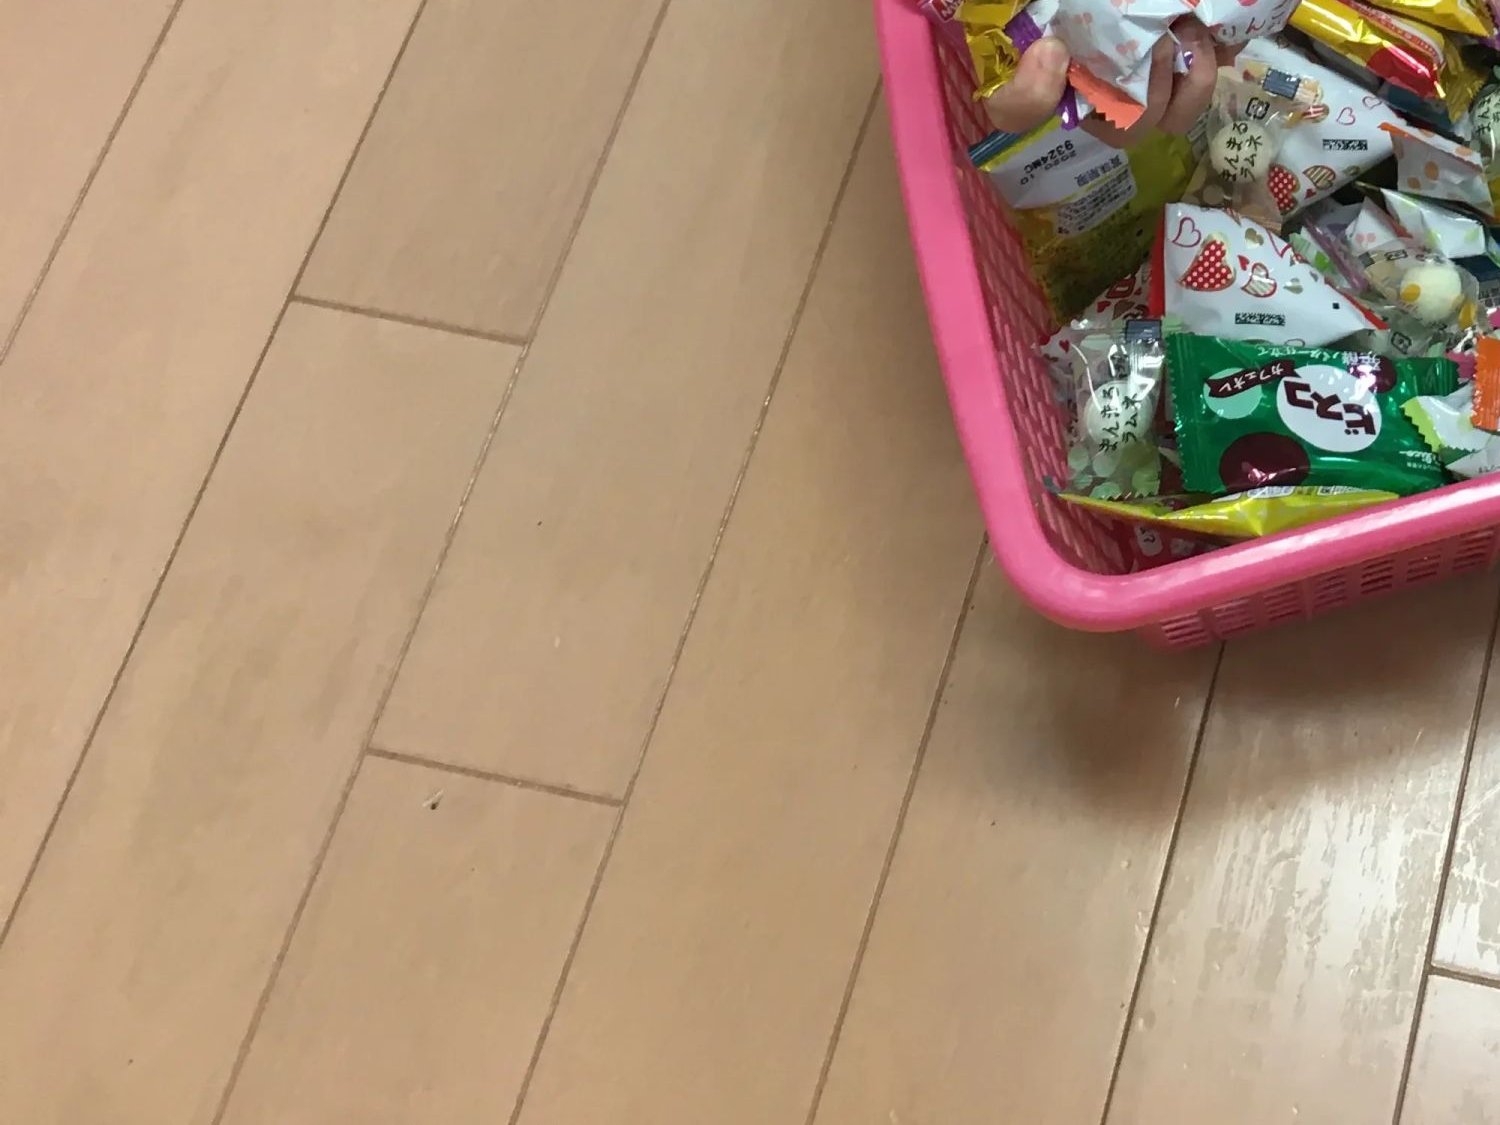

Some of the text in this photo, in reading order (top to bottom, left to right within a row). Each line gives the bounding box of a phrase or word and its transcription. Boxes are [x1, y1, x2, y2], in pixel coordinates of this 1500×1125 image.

[1223, 122, 1249, 182] まんまる
[1239, 134, 1264, 178] ラムネ
[1218, 362, 1286, 394] カフェオレ
[1283, 380, 1377, 440] ビスコ
